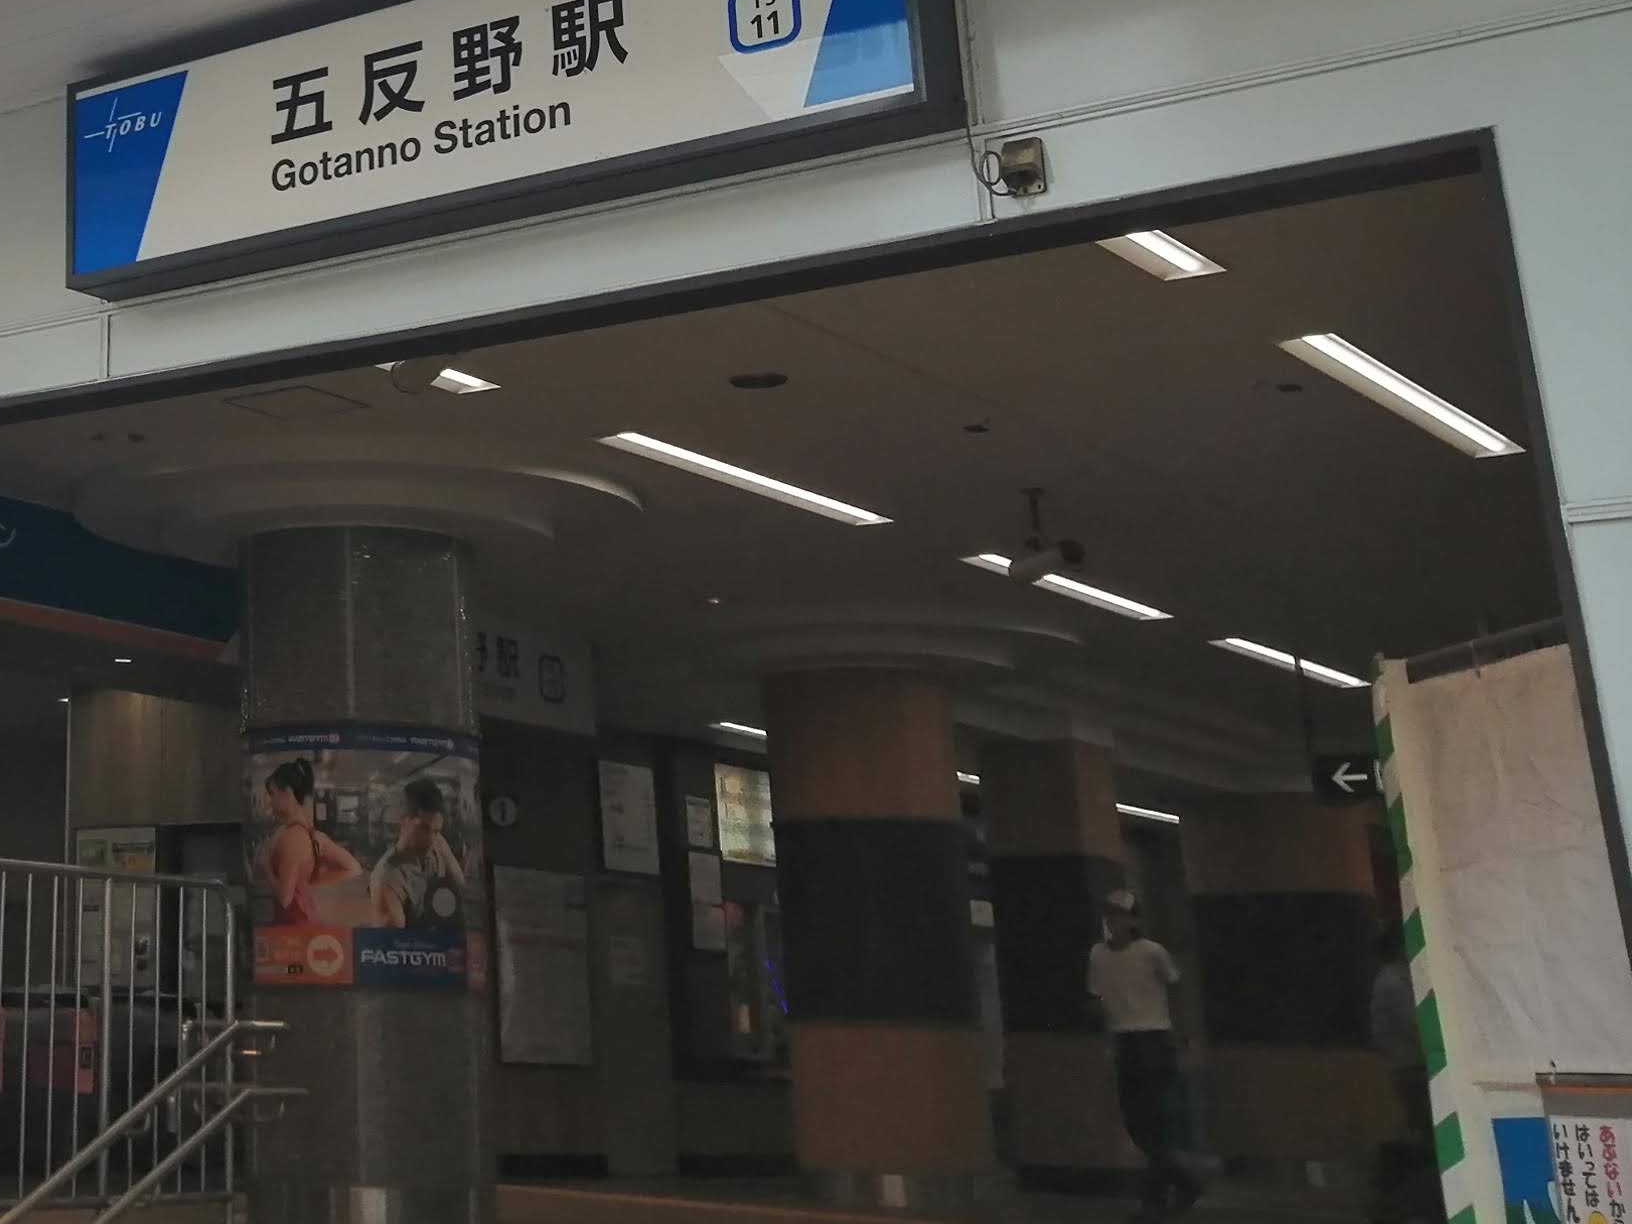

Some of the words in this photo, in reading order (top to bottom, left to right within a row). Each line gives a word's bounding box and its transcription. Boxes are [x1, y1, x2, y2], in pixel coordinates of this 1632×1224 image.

[749, 9, 780, 39] 11
[104, 110, 163, 140] TOBU
[270, 136, 422, 192] Gotanno
[433, 100, 572, 155] Station
[1574, 1123, 1601, 1208] はいっては
